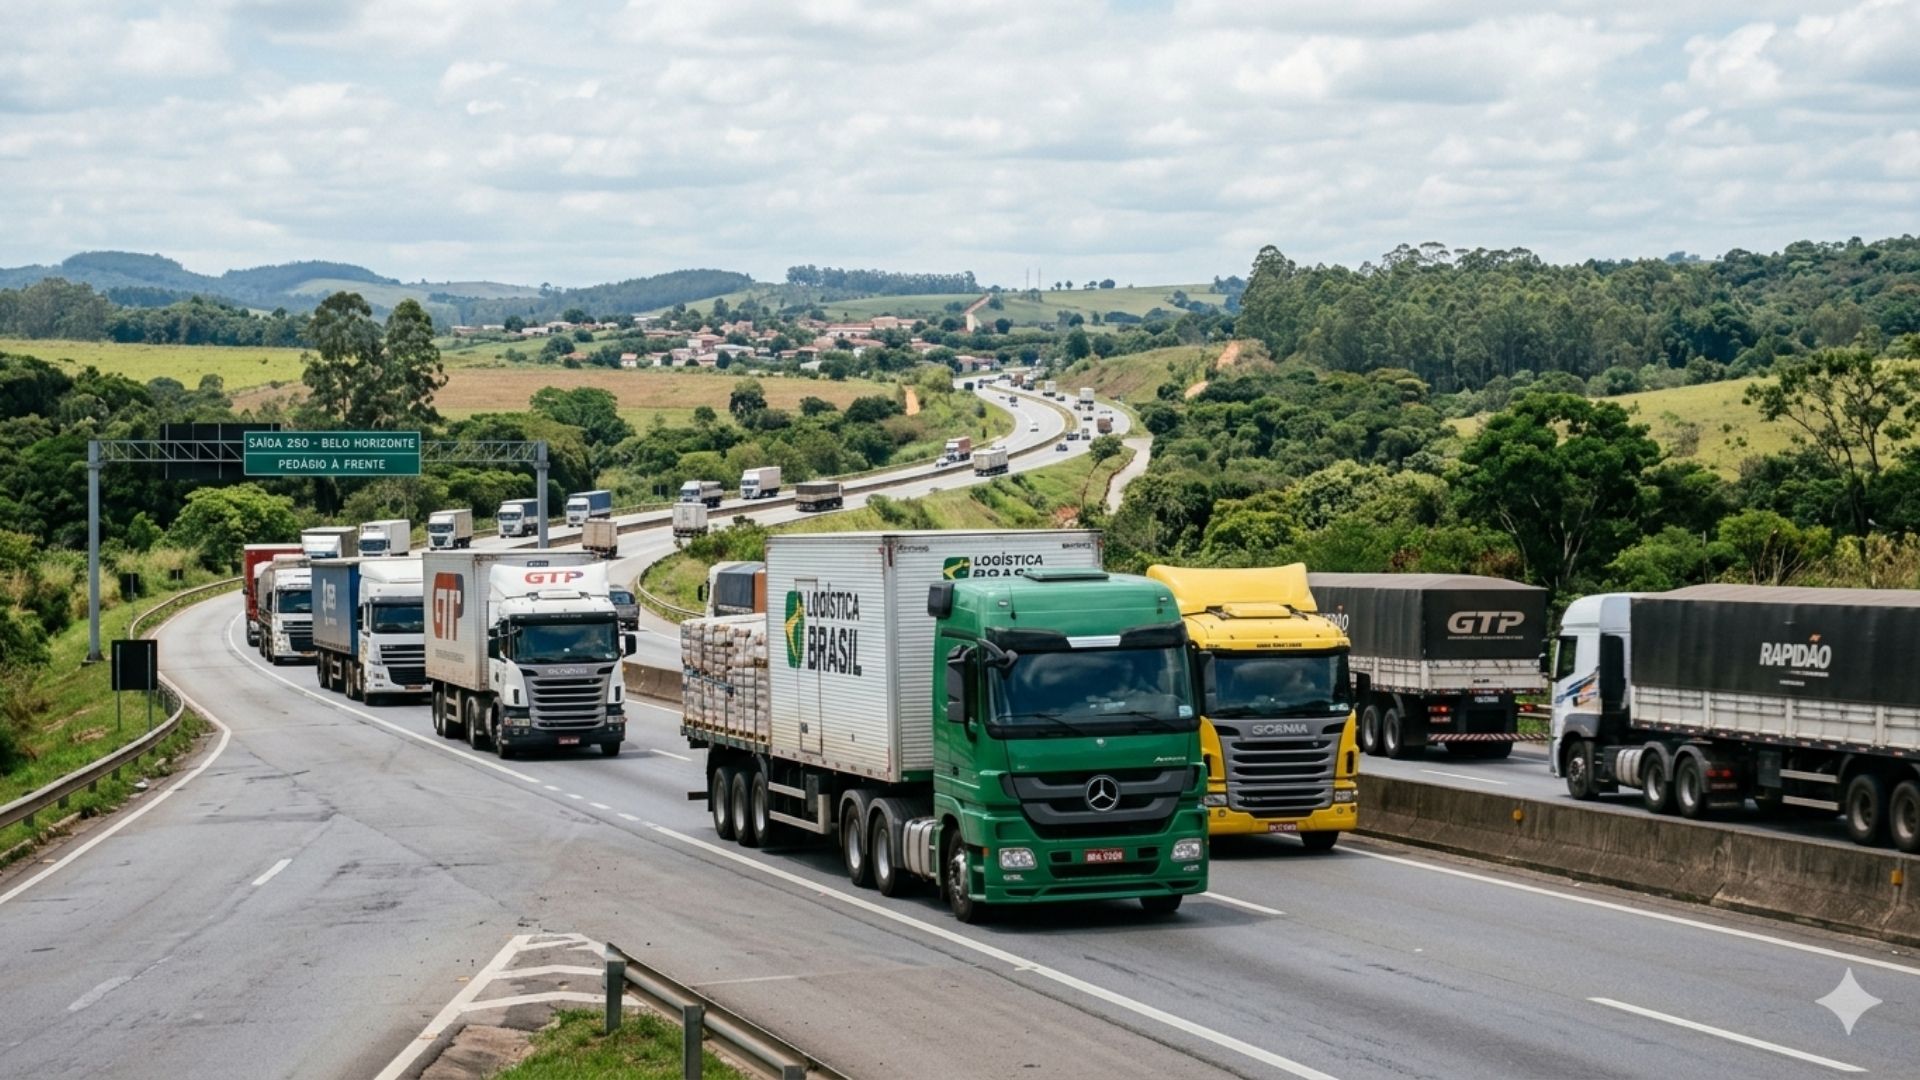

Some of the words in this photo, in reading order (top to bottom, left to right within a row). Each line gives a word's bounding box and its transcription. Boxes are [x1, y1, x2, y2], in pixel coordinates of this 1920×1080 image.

[321, 438, 350, 448] BELO
[354, 438, 415, 448] HORIZONTE
[344, 459, 386, 469] FRENTE
[973, 552, 1044, 567] LOGÍSTICA
[525, 571, 584, 584] GTP
[433, 572, 464, 641] GTP
[807, 582, 860, 621] LOGÍSTICA
[1447, 611, 1525, 634] GTP
[808, 626, 862, 676] BRASIL
